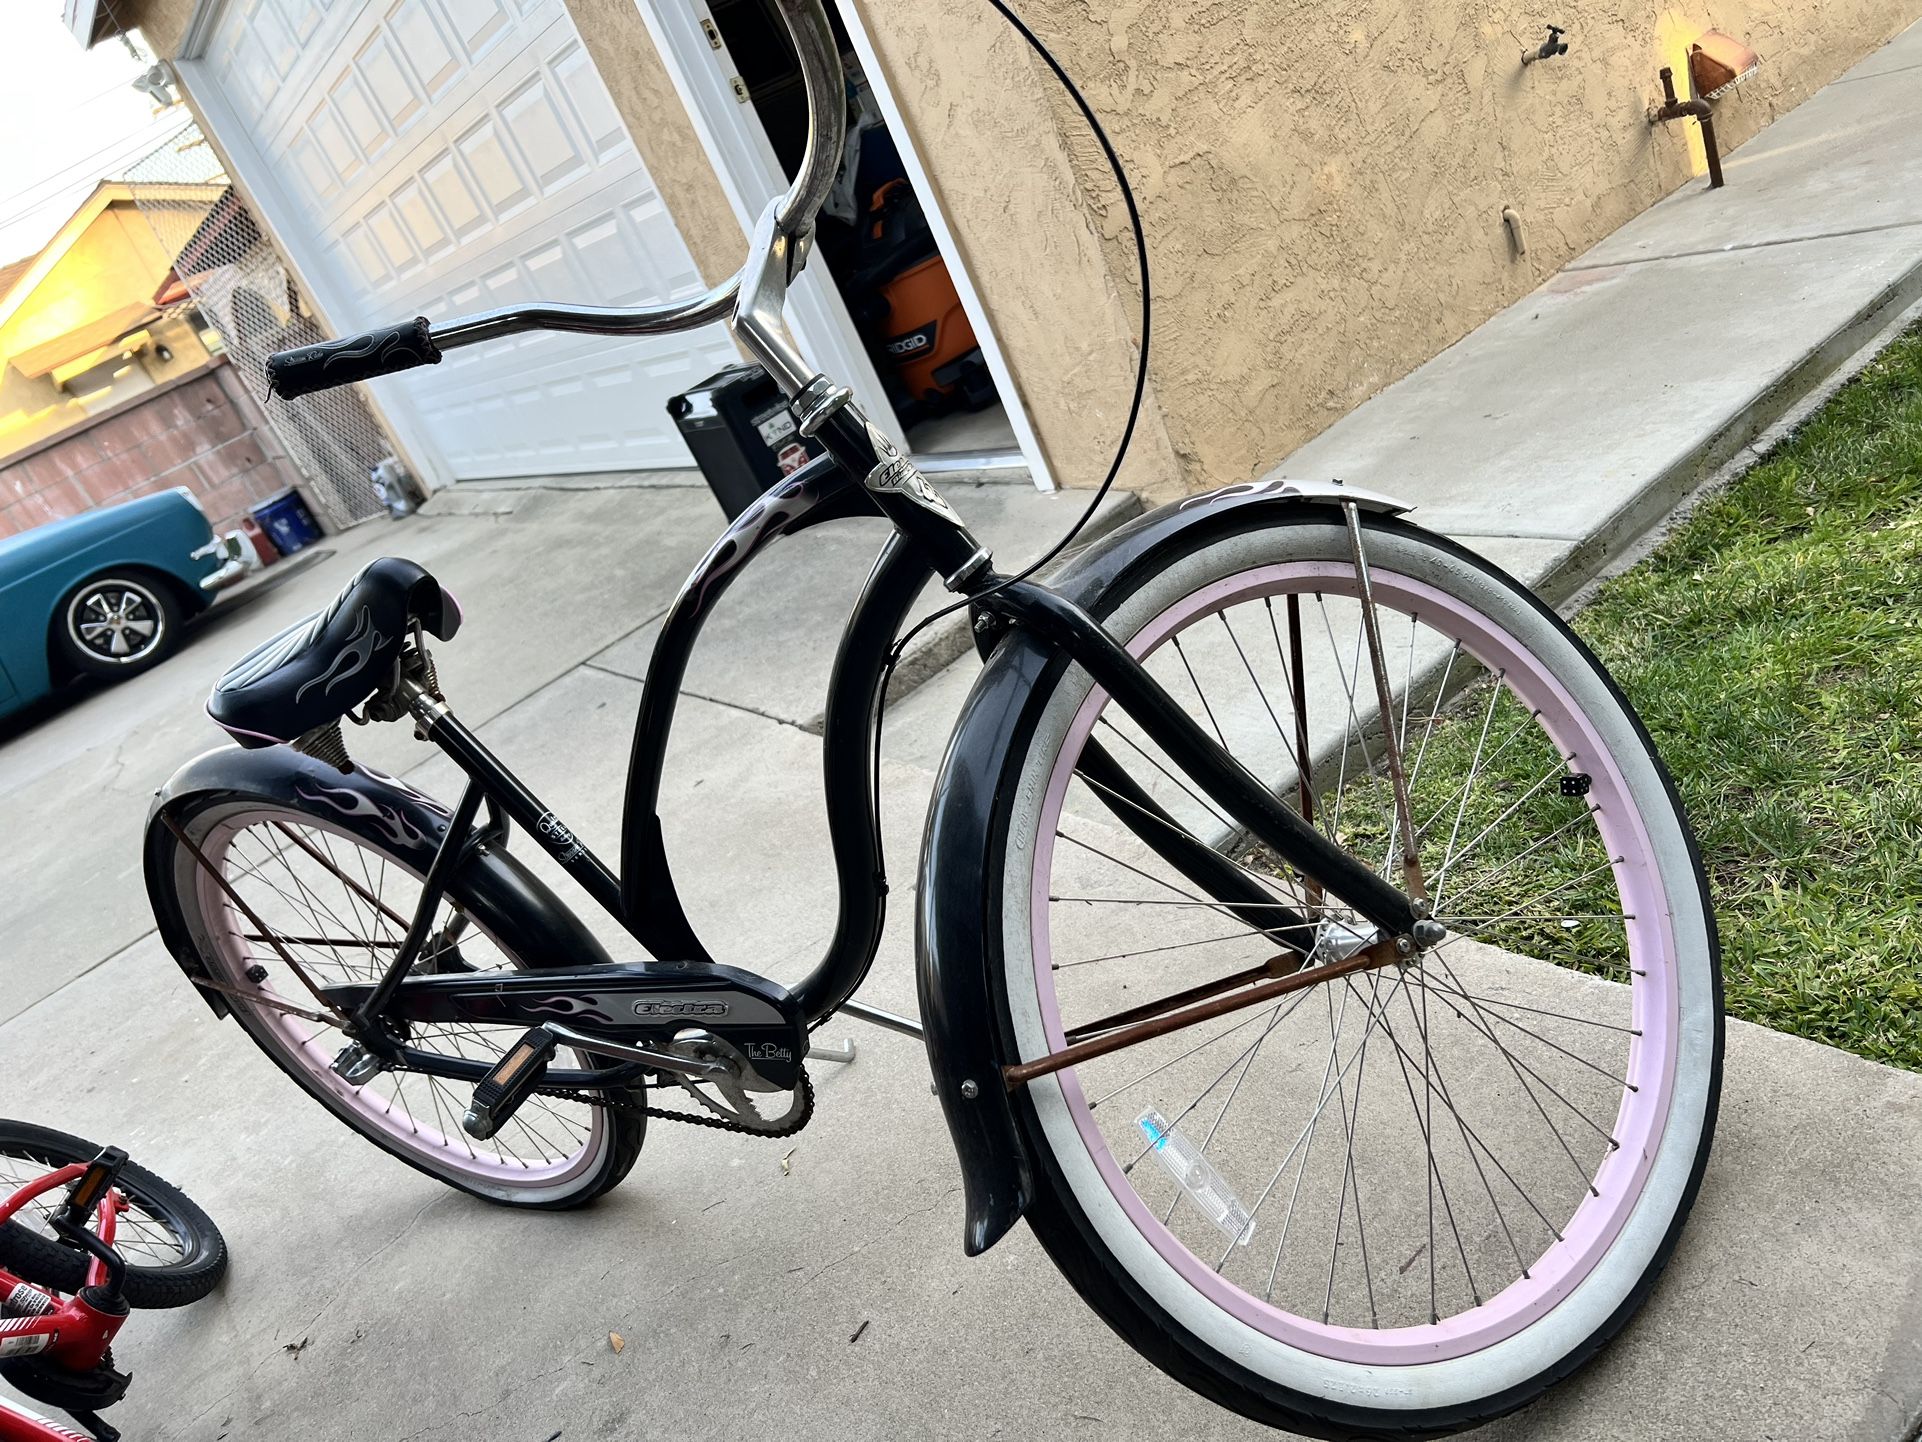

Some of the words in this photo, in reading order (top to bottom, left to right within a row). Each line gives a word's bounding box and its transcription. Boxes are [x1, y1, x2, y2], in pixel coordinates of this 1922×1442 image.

[886, 334, 928, 354] RIDGID
[634, 1002, 727, 1016] Electra
[744, 1043, 762, 1059] The
[761, 1043, 792, 1063] Betty
